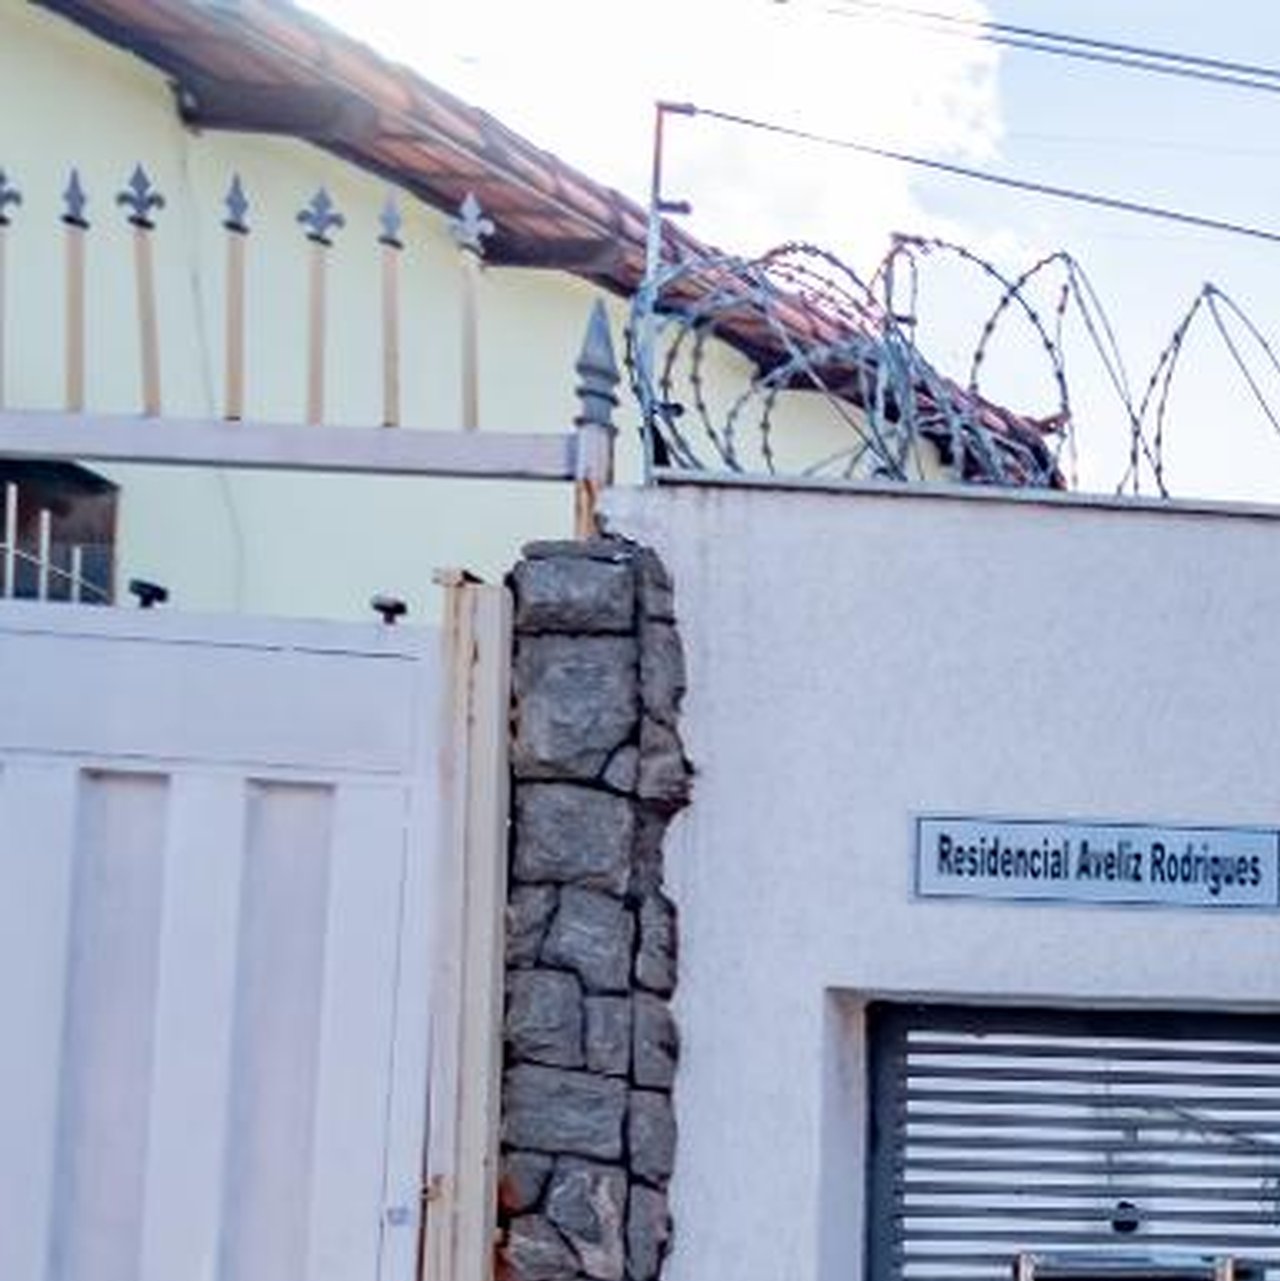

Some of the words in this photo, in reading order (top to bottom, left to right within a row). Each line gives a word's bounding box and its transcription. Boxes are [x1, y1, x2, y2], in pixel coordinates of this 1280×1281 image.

[937, 834, 1069, 880] Residencial
[1076, 840, 1142, 882] Aveliz
[1150, 842, 1262, 895] Rodrigues
